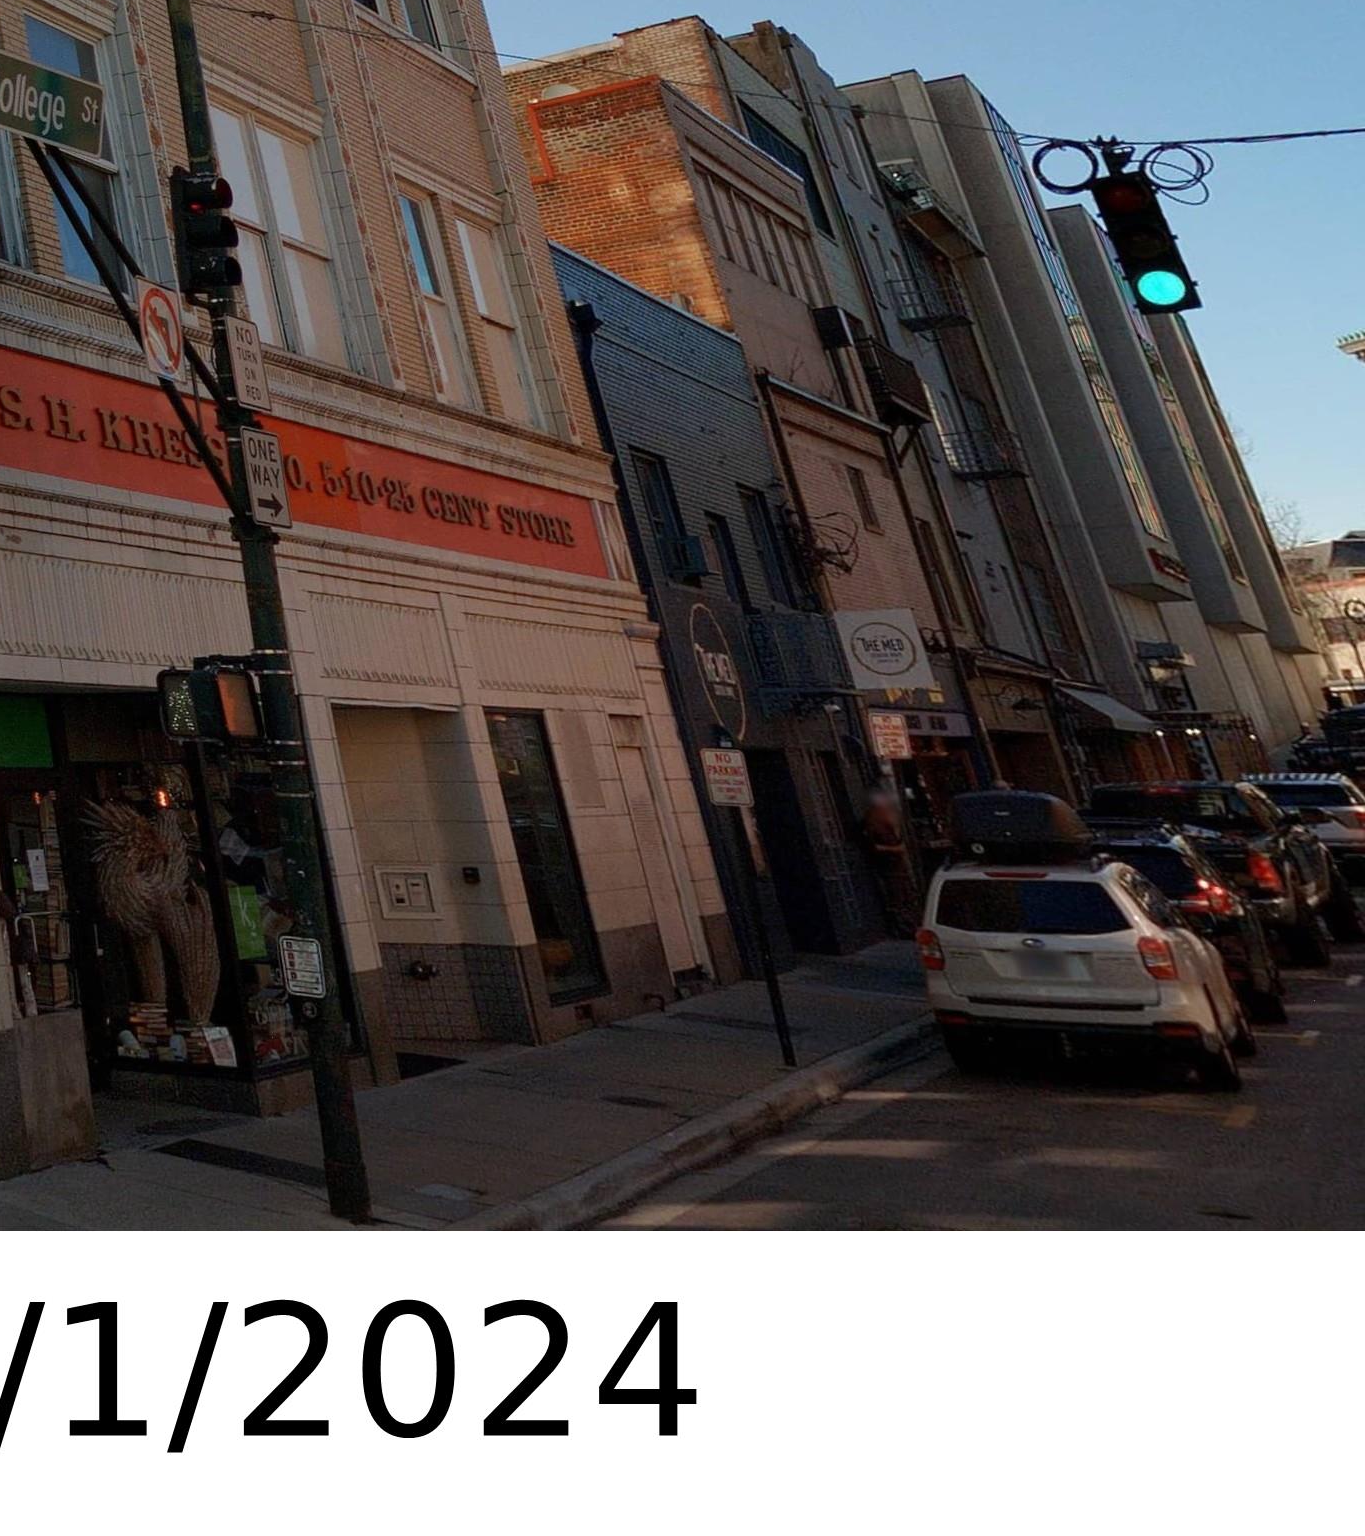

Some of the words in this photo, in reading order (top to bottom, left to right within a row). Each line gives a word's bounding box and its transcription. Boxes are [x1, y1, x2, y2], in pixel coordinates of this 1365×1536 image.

[81, 95, 99, 125] St
[234, 326, 253, 346] NO
[236, 347, 258, 363] TURN
[244, 367, 257, 381] ON
[245, 384, 262, 401] RED
[247, 437, 278, 463] ONE
[250, 463, 281, 489] WAY
[422, 486, 491, 531] CENT
[497, 504, 577, 548] STORE
[881, 639, 905, 651] MED
[714, 753, 732, 764] NO
[707, 765, 746, 777] PARKING
